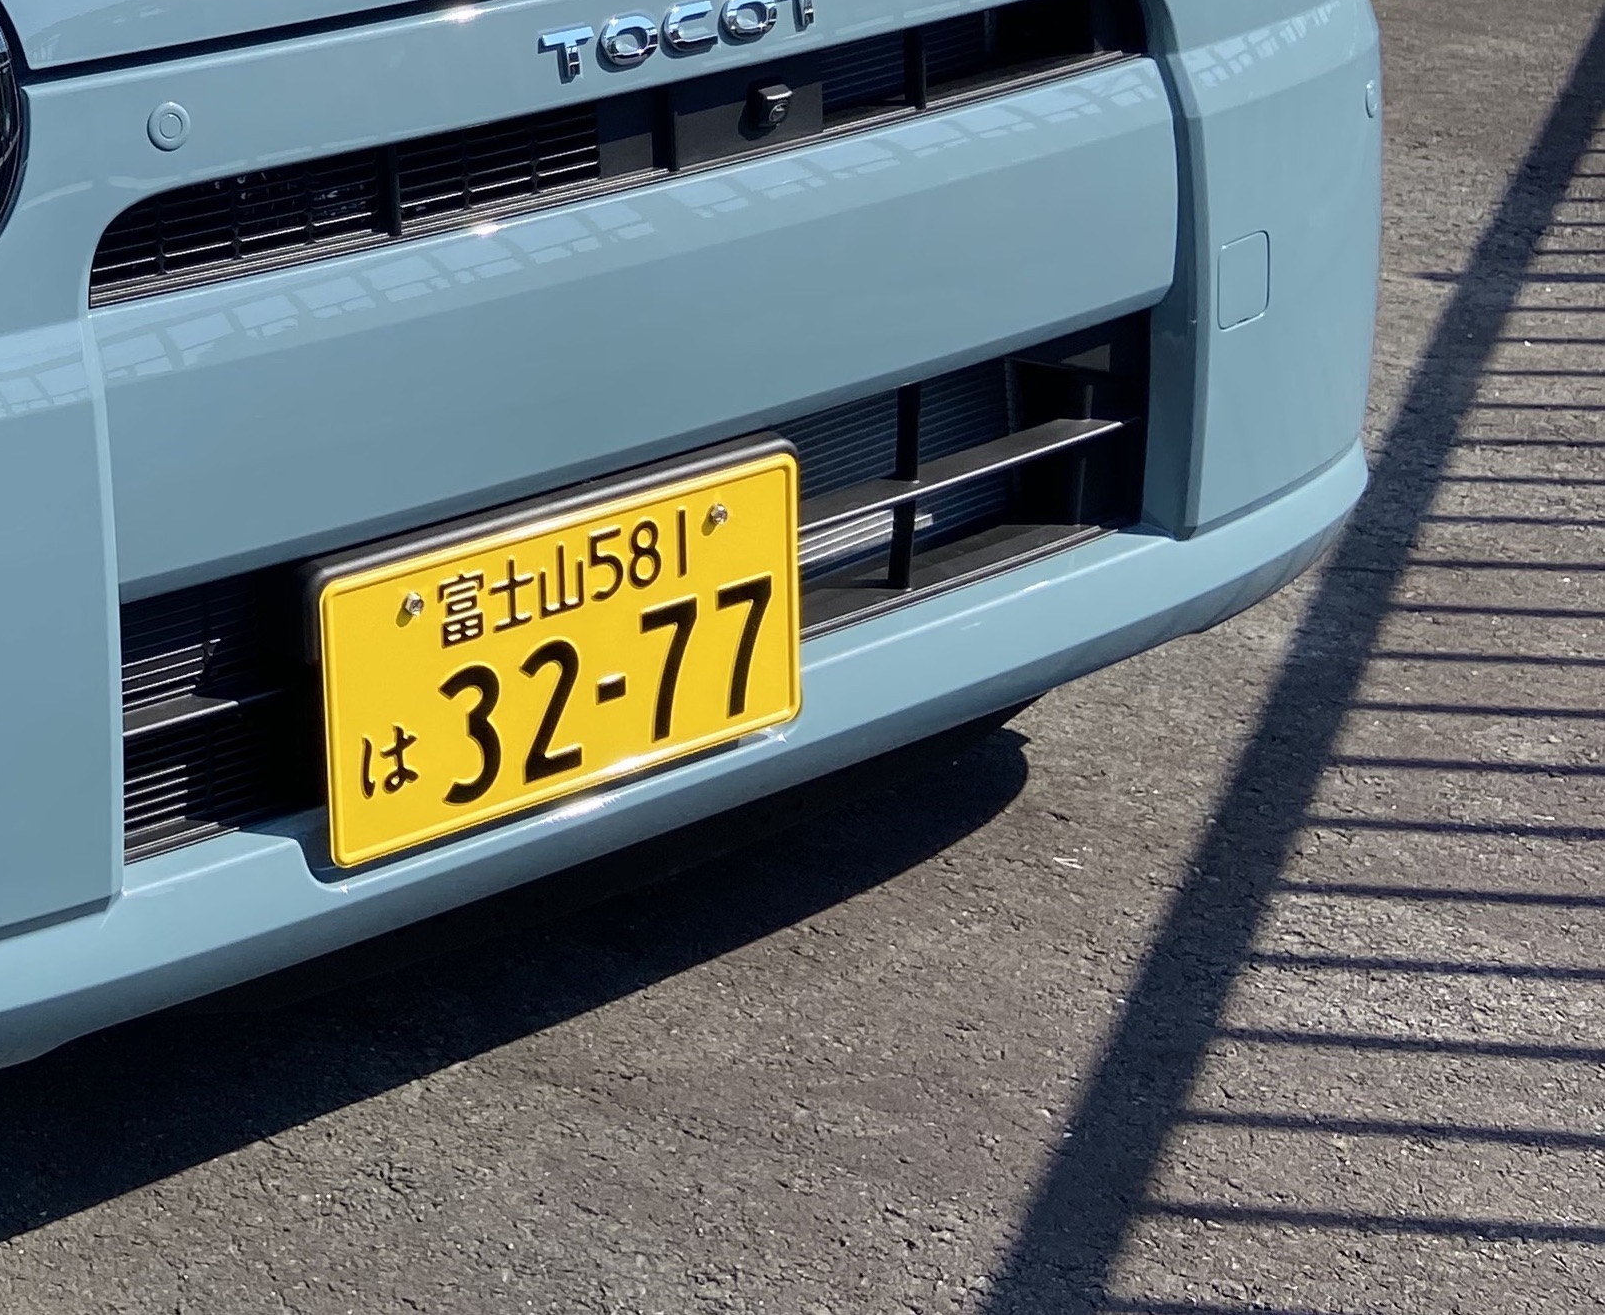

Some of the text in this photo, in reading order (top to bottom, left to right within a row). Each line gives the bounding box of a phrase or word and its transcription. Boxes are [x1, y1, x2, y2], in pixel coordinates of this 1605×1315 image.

[436, 507, 687, 649] 富士山581
[361, 572, 773, 805] は 32-77
